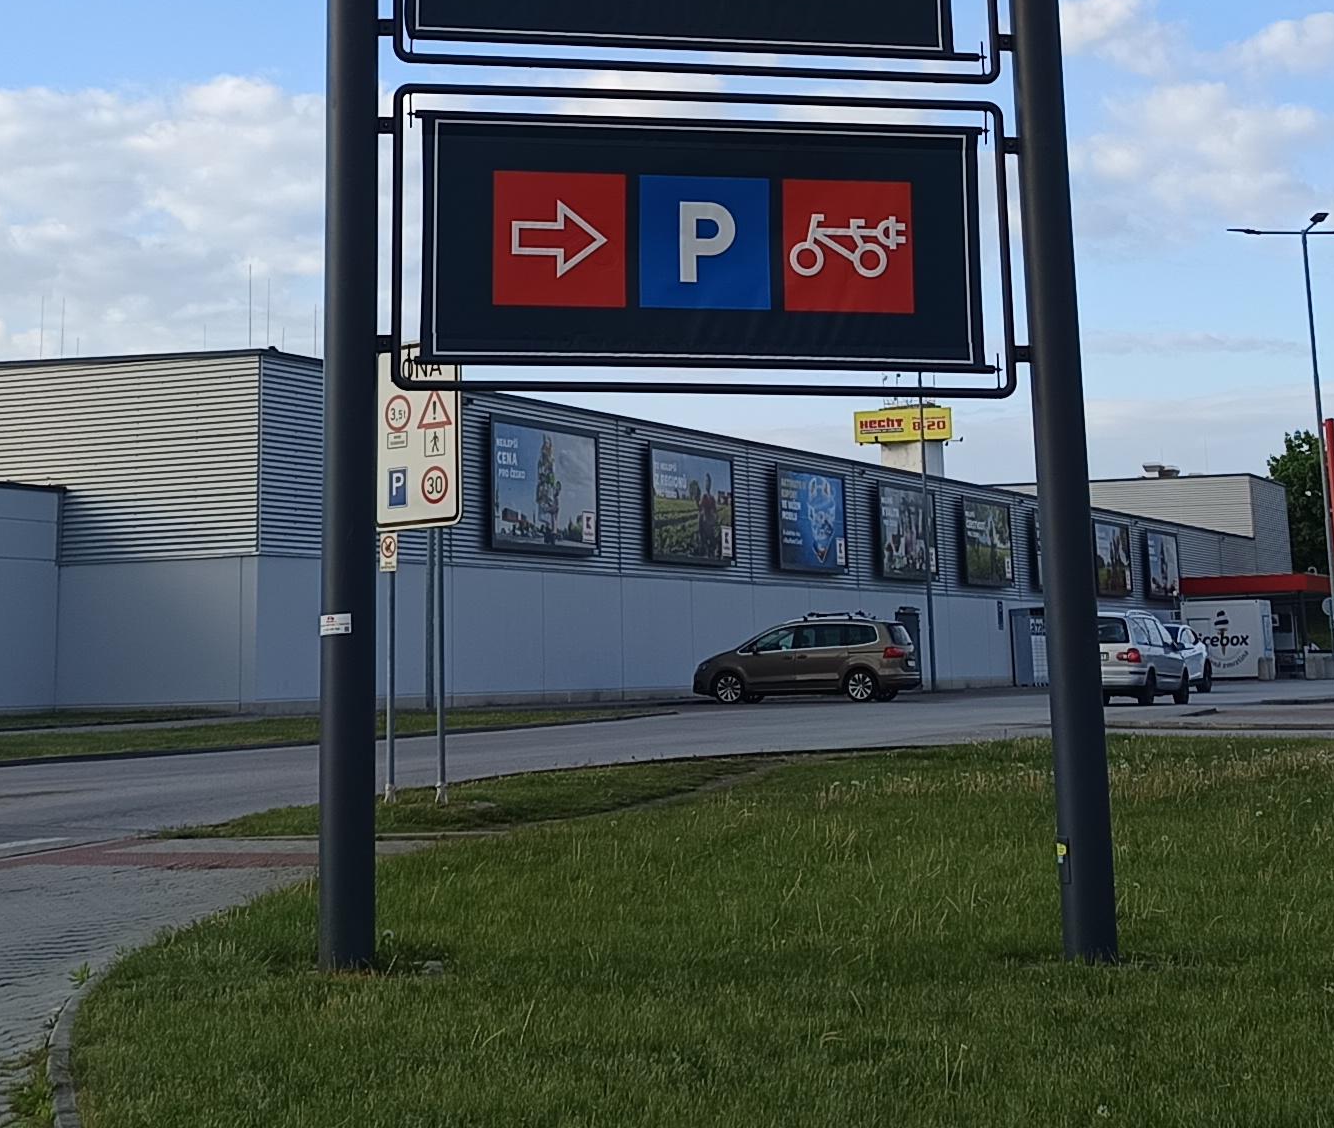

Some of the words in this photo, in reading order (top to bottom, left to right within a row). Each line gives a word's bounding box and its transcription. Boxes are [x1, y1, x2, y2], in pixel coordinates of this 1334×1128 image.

[679, 200, 736, 283] P
[497, 451, 518, 466] CENA
[392, 472, 405, 497] P
[426, 475, 444, 495] 30
